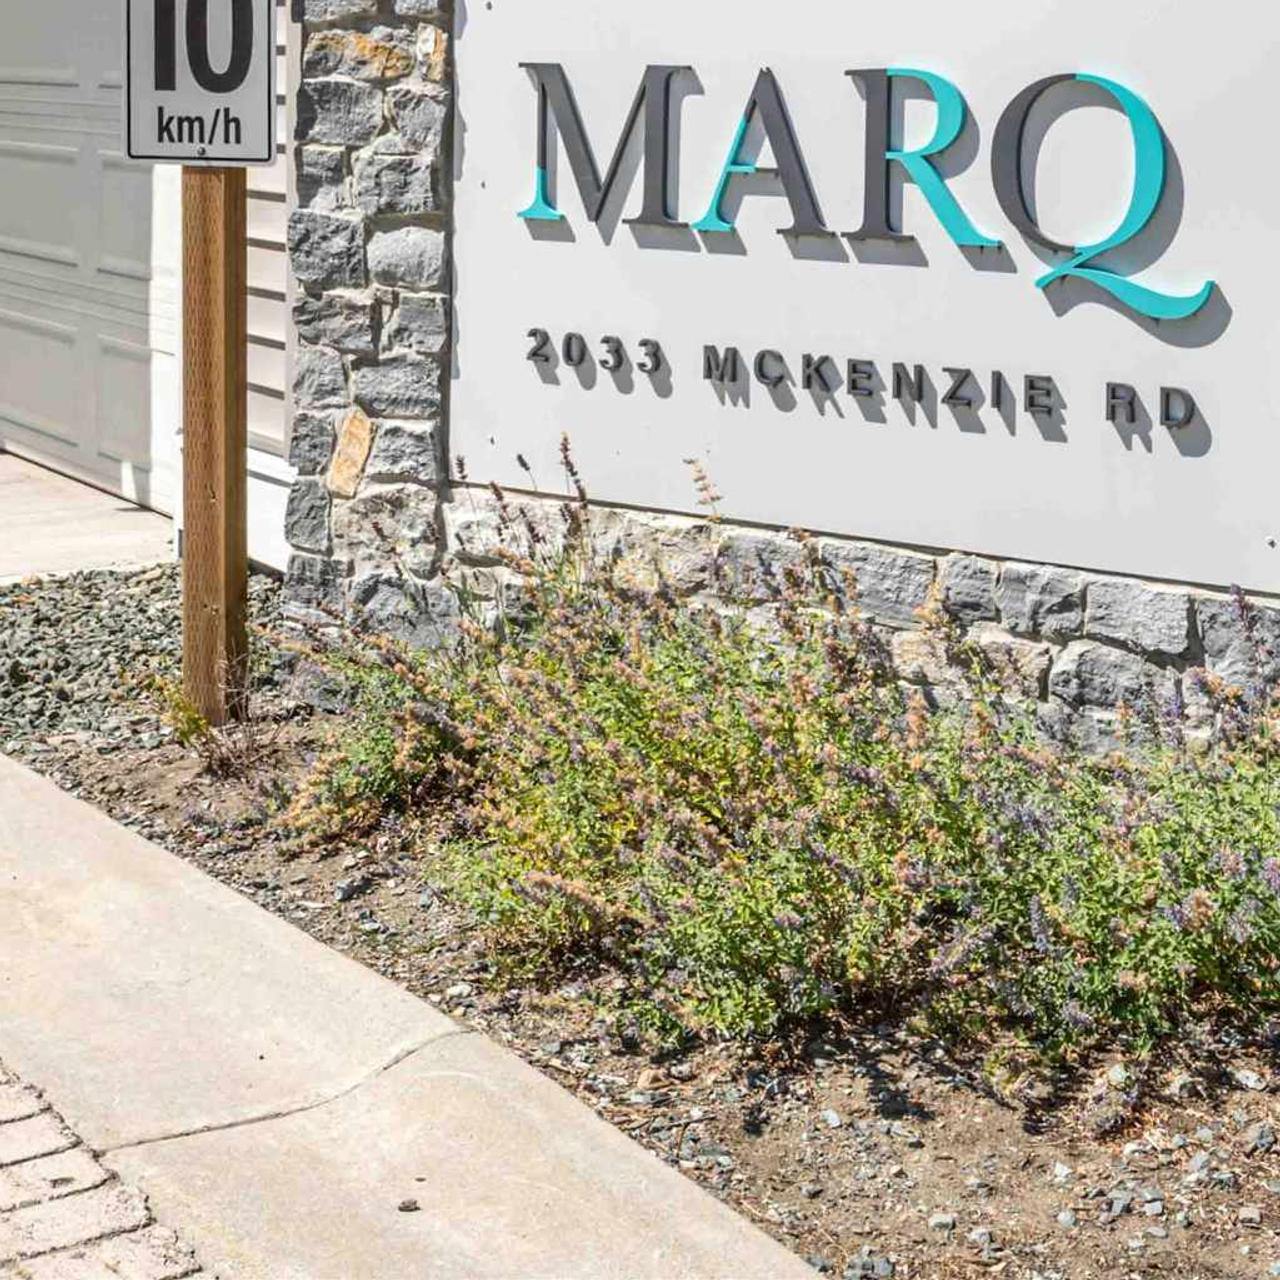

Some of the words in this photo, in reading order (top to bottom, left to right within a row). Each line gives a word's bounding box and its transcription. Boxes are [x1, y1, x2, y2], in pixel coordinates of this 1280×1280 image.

[157, 106, 241, 144] km/h
[517, 62, 1216, 321] MARQ
[526, 329, 663, 374] 2033
[702, 344, 1054, 415] MCKENZIE
[1106, 383, 1195, 431] RD
